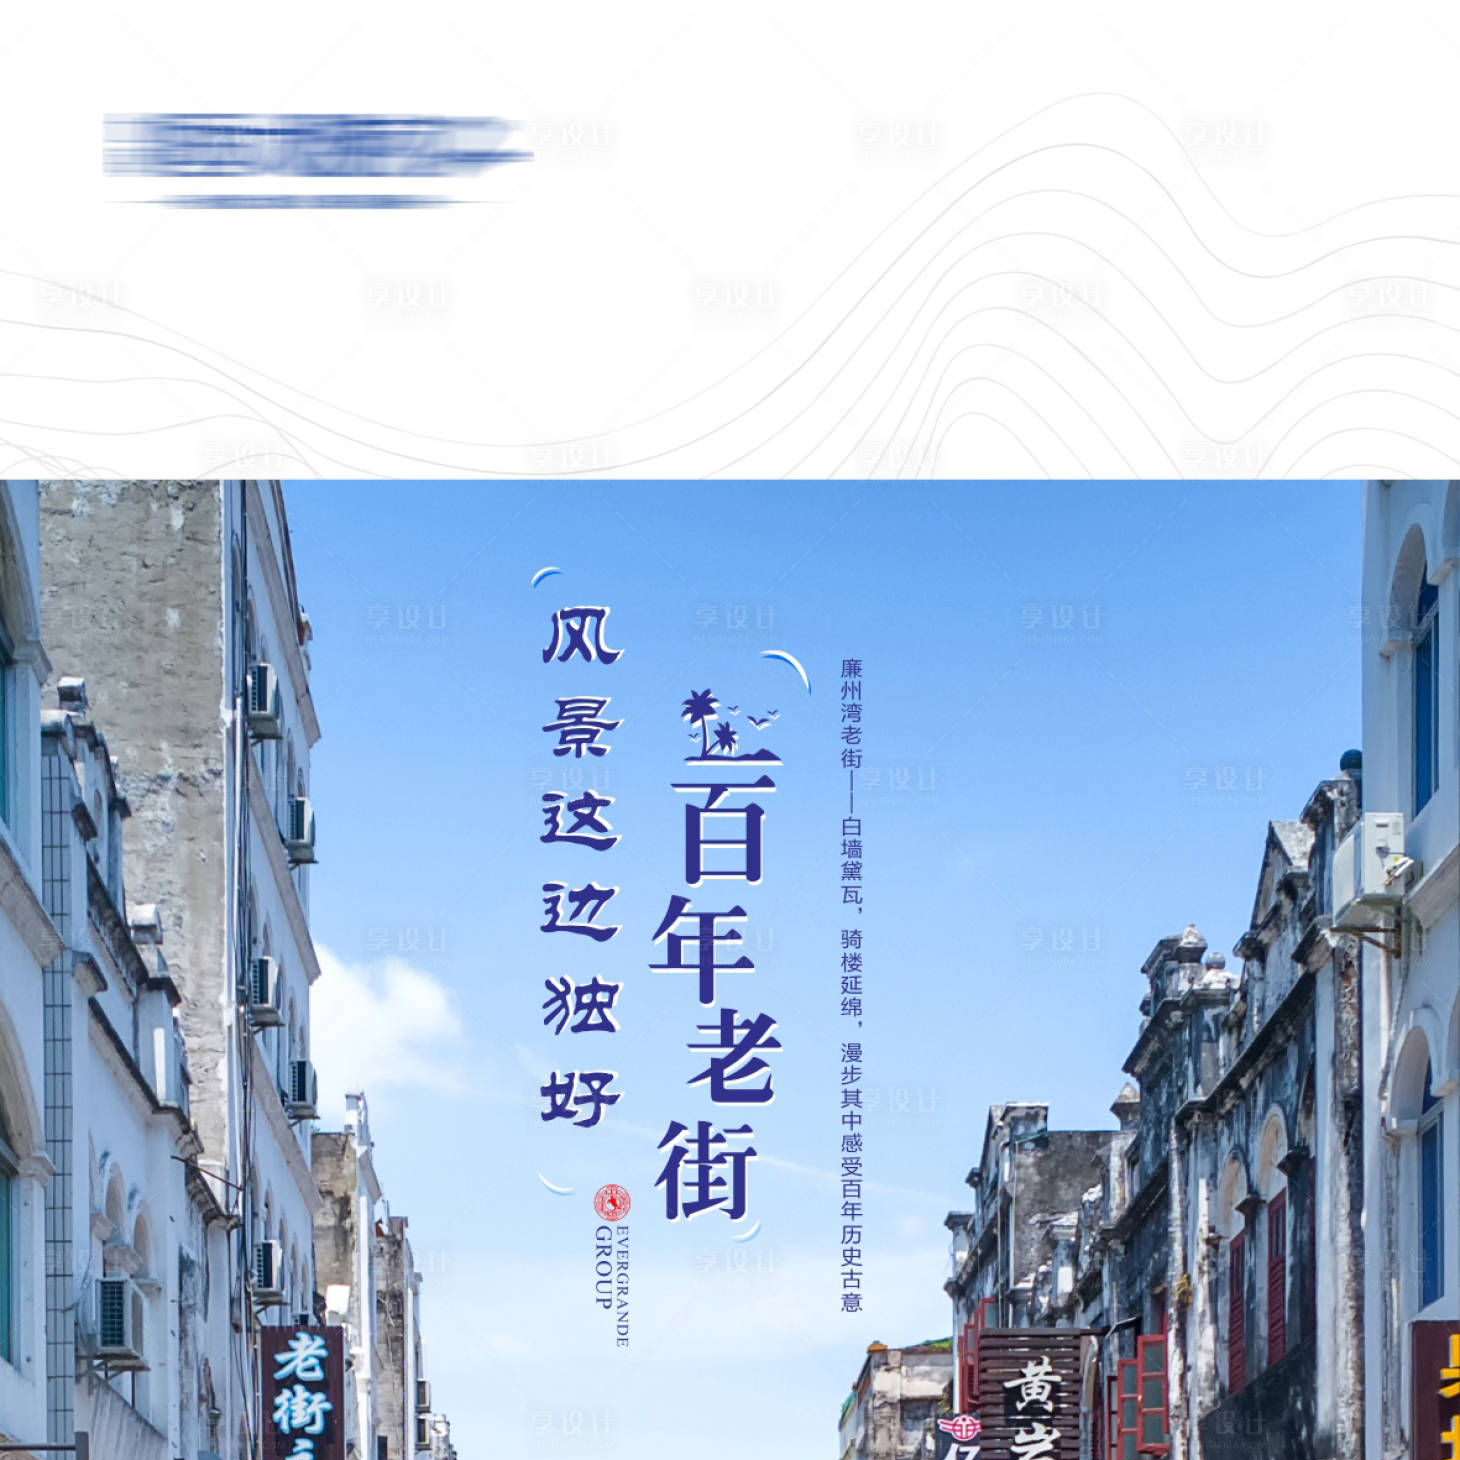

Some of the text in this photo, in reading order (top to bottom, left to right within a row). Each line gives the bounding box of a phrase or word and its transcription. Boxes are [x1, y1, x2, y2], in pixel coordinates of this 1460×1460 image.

[540, 606, 623, 1128] 风景这边独好
[595, 1225, 613, 1310] GROUP
[616, 1226, 629, 1347] EVERGRANDE
